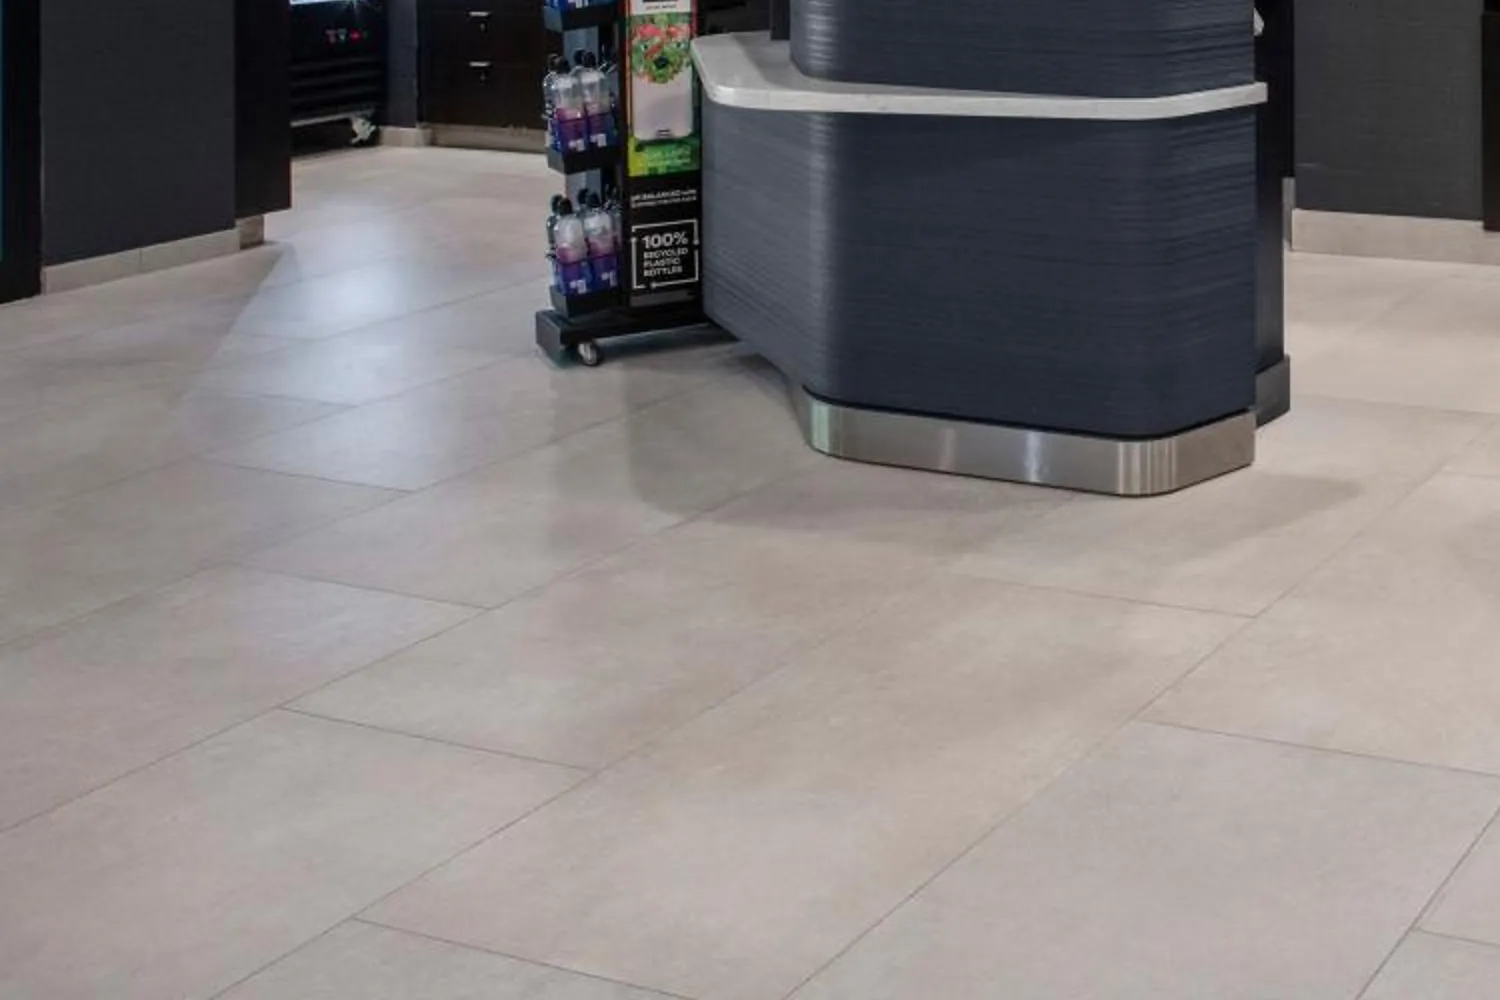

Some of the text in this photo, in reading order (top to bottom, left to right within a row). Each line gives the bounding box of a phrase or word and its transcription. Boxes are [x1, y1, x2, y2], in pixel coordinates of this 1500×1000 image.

[641, 231, 689, 249] 100%
[643, 247, 689, 259] RECYCLED
[643, 258, 681, 267] PLASTIC
[643, 265, 683, 277] BOTTLES
